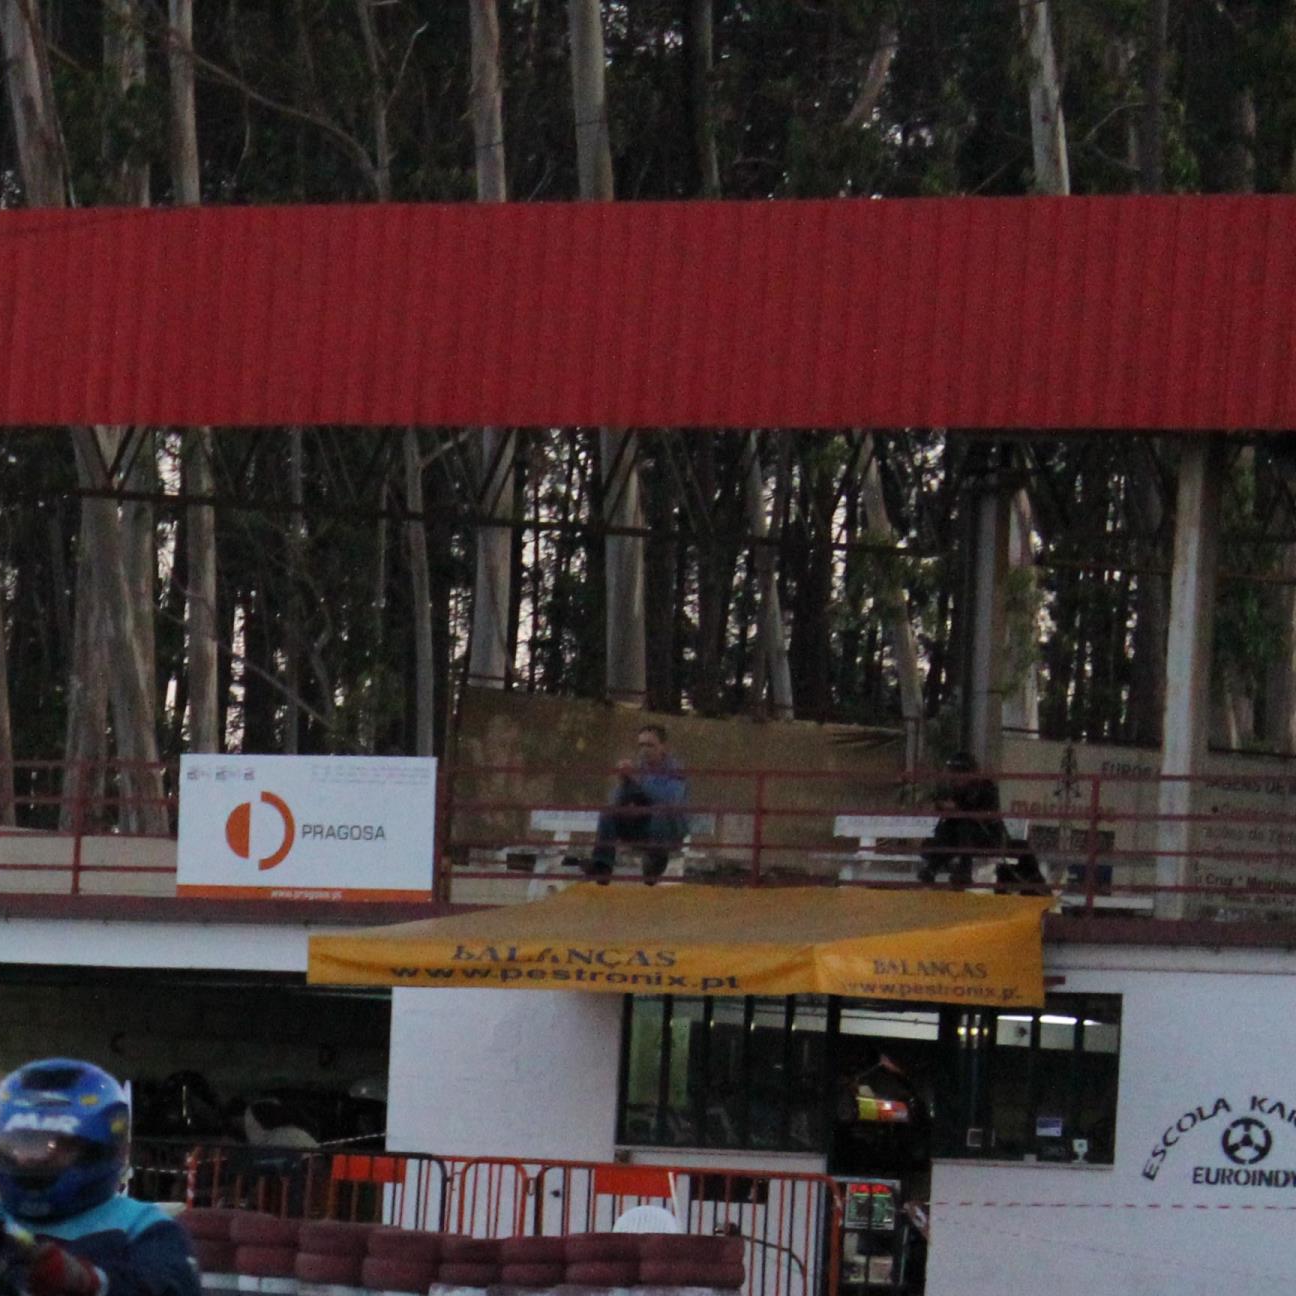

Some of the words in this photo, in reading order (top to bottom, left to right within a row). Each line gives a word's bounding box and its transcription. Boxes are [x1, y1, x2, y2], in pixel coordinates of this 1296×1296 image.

[301, 824, 387, 841] PRAGOSA
[391, 965, 741, 991] www.pestronix.pt
[873, 959, 988, 979] BALANÇAS
[1141, 1097, 1232, 1182] ESCOLA
